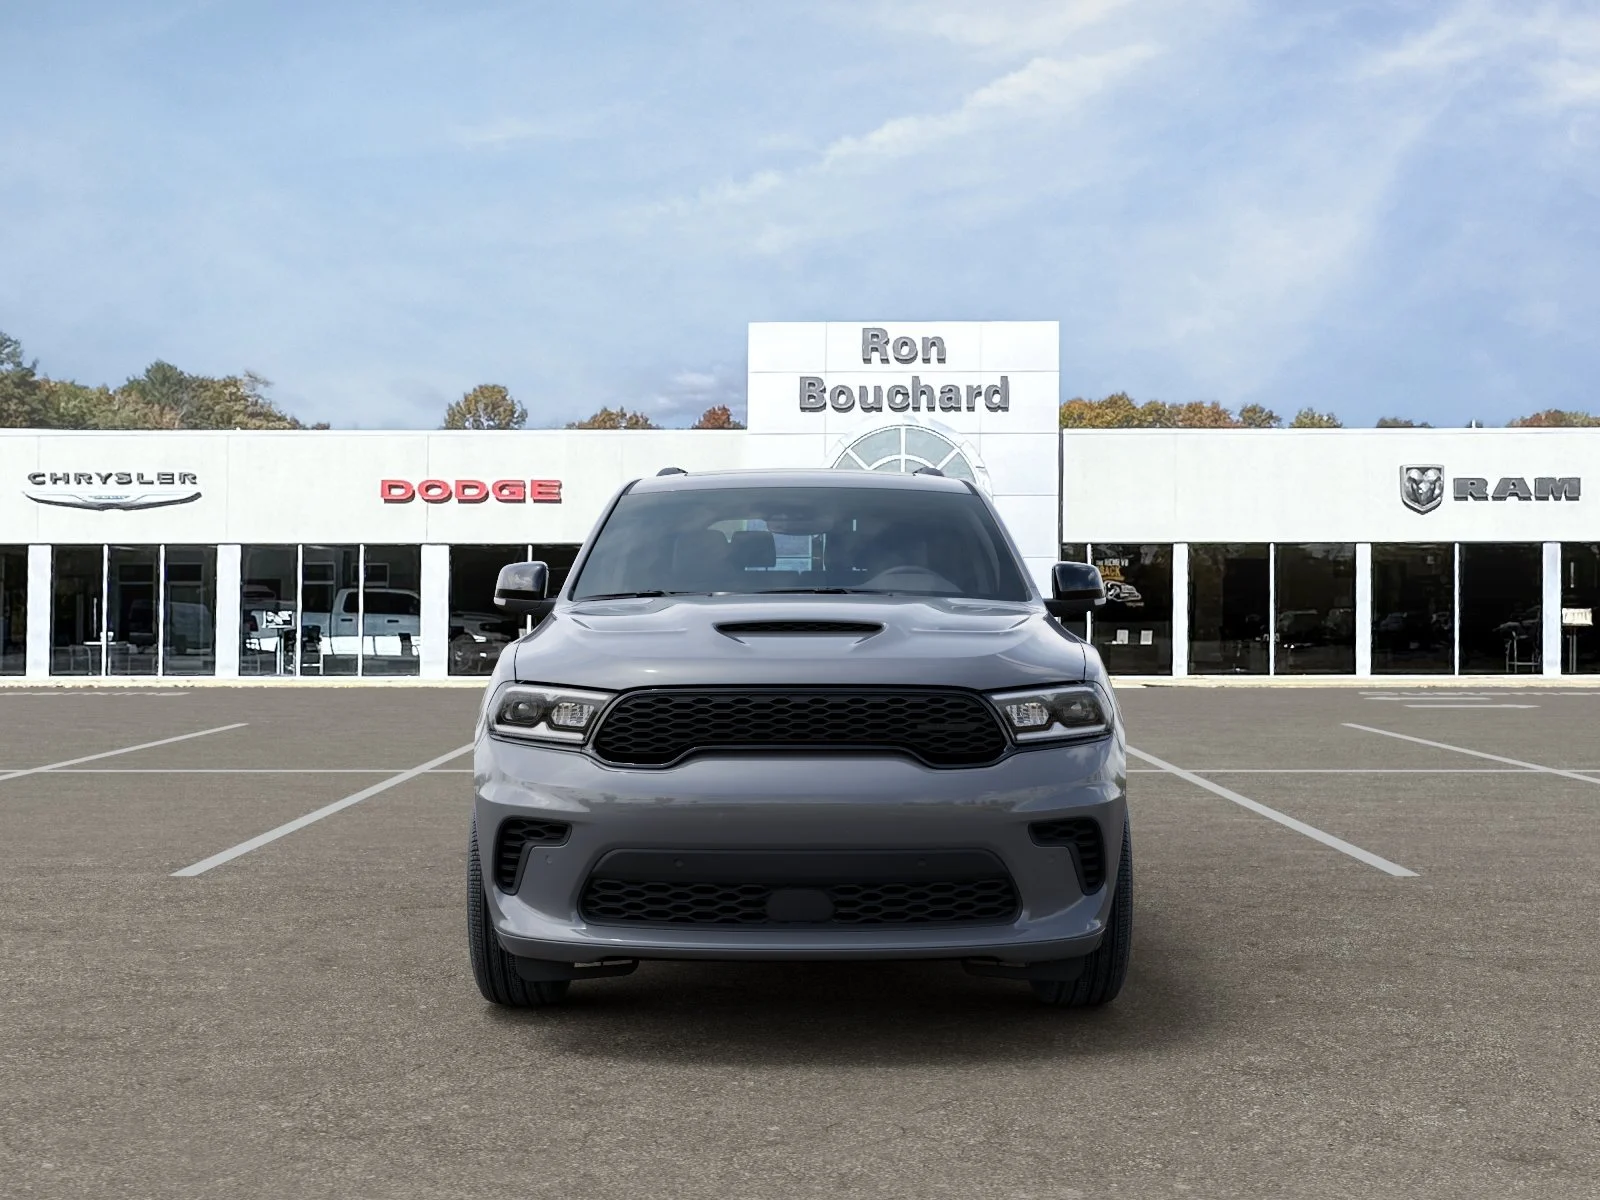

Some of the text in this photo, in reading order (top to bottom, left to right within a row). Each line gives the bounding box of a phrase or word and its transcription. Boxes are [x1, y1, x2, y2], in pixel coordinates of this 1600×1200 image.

[862, 328, 947, 364] Ron
[800, 376, 1010, 413] Bouchard
[28, 471, 198, 486] CHRYSLER
[1453, 477, 1582, 501] RAM
[381, 479, 563, 504] DODGE
